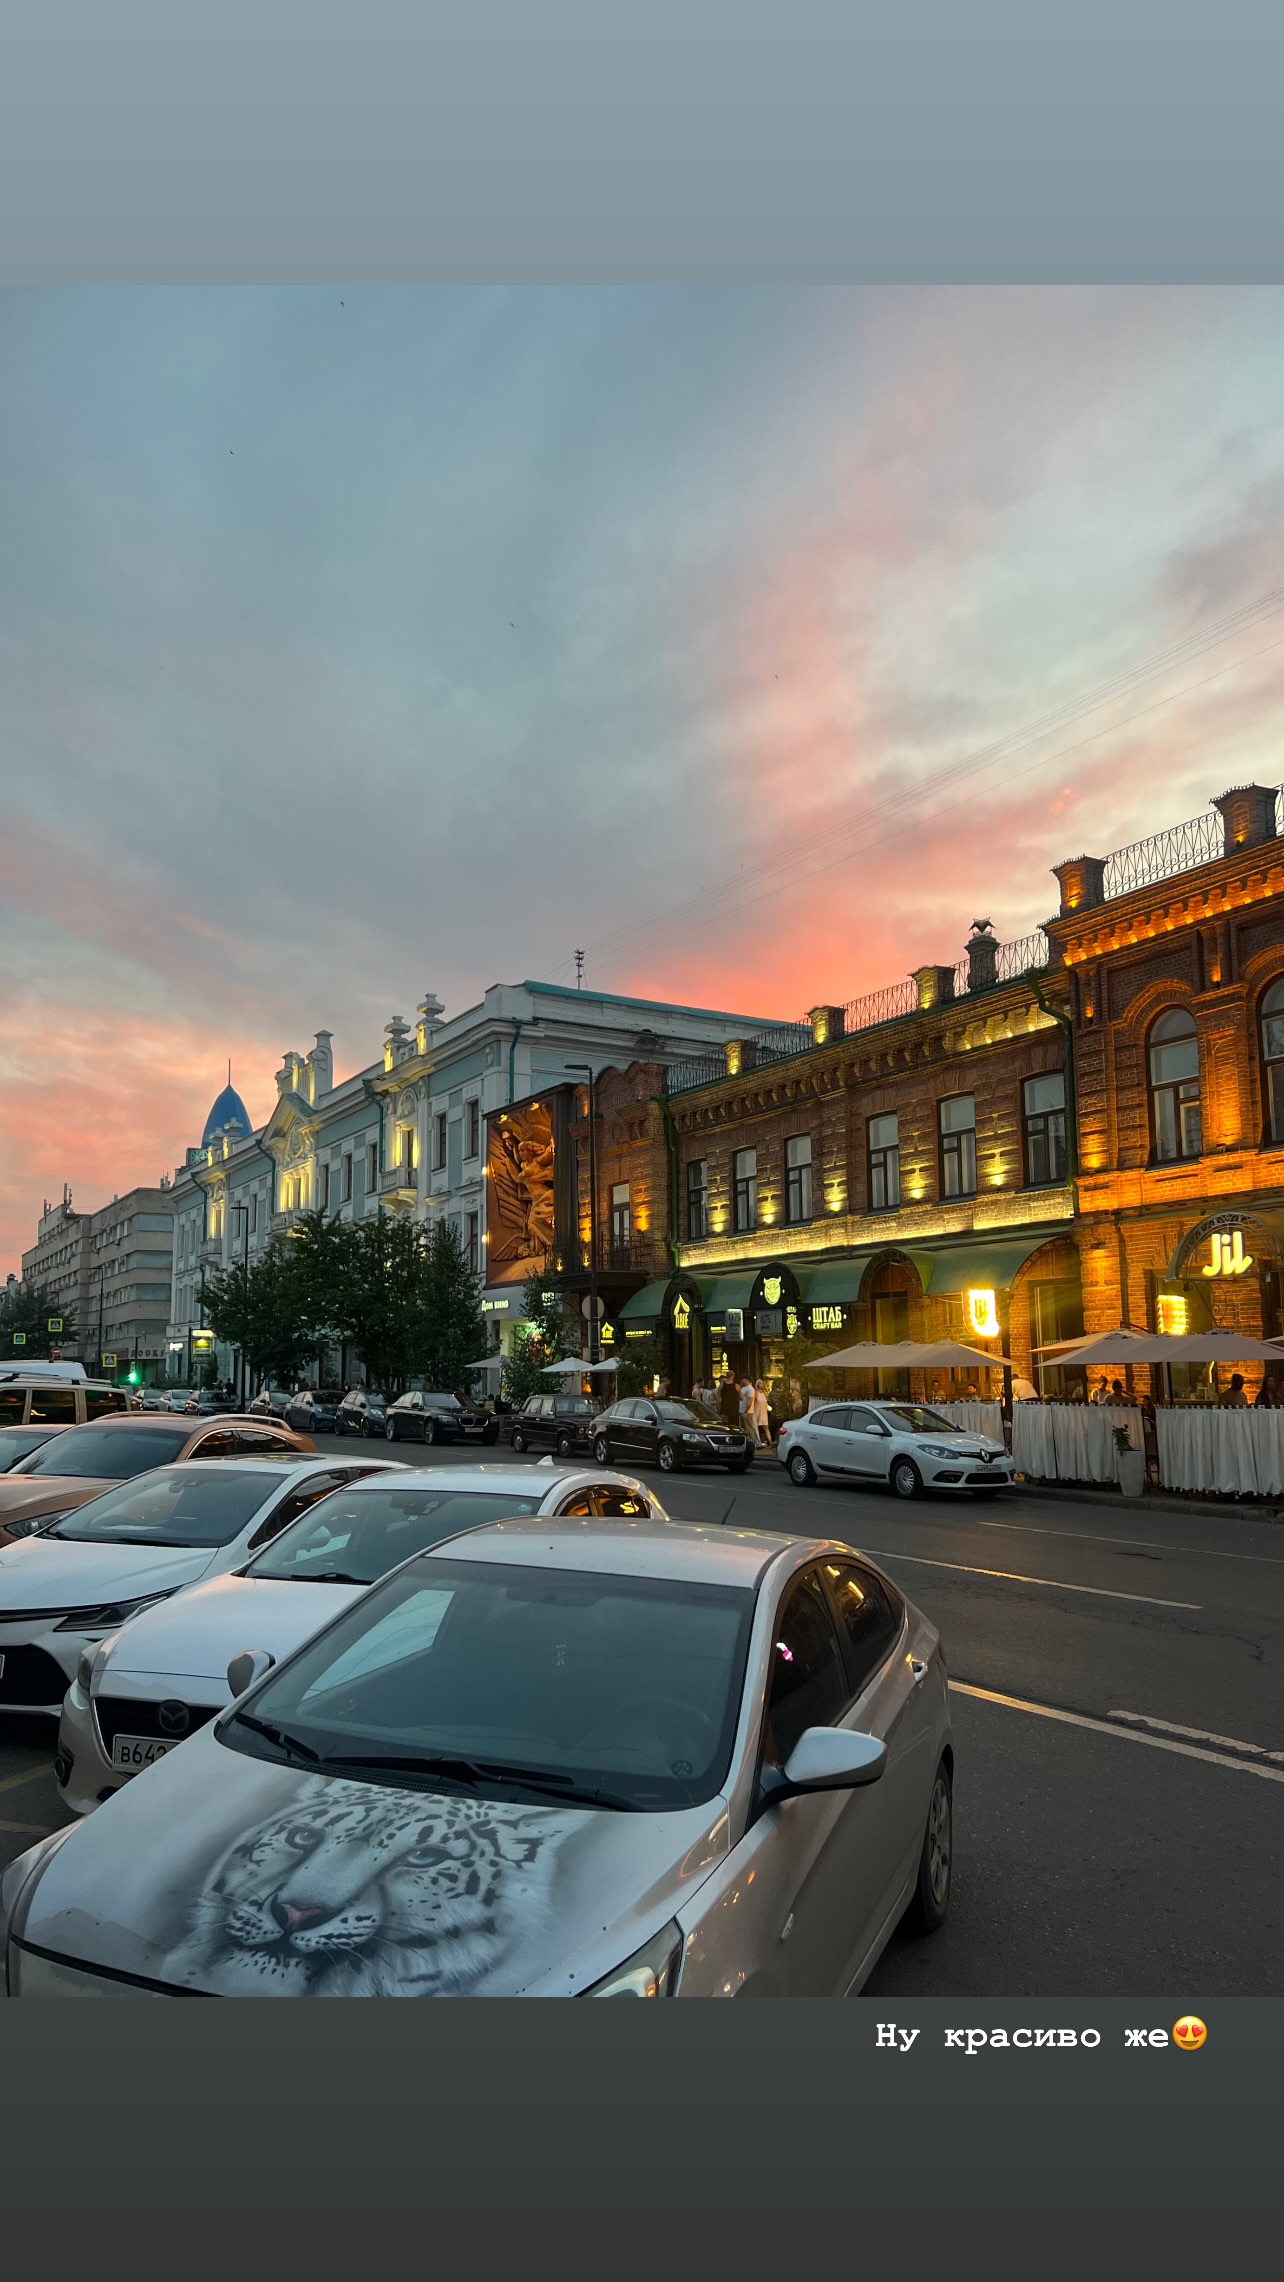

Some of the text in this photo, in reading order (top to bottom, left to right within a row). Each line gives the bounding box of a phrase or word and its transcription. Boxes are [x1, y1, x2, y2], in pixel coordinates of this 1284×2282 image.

[481, 1299, 494, 1312] Дом
[812, 1306, 842, 1323] ШТАБ
[812, 1322, 831, 1330] CRAFT
